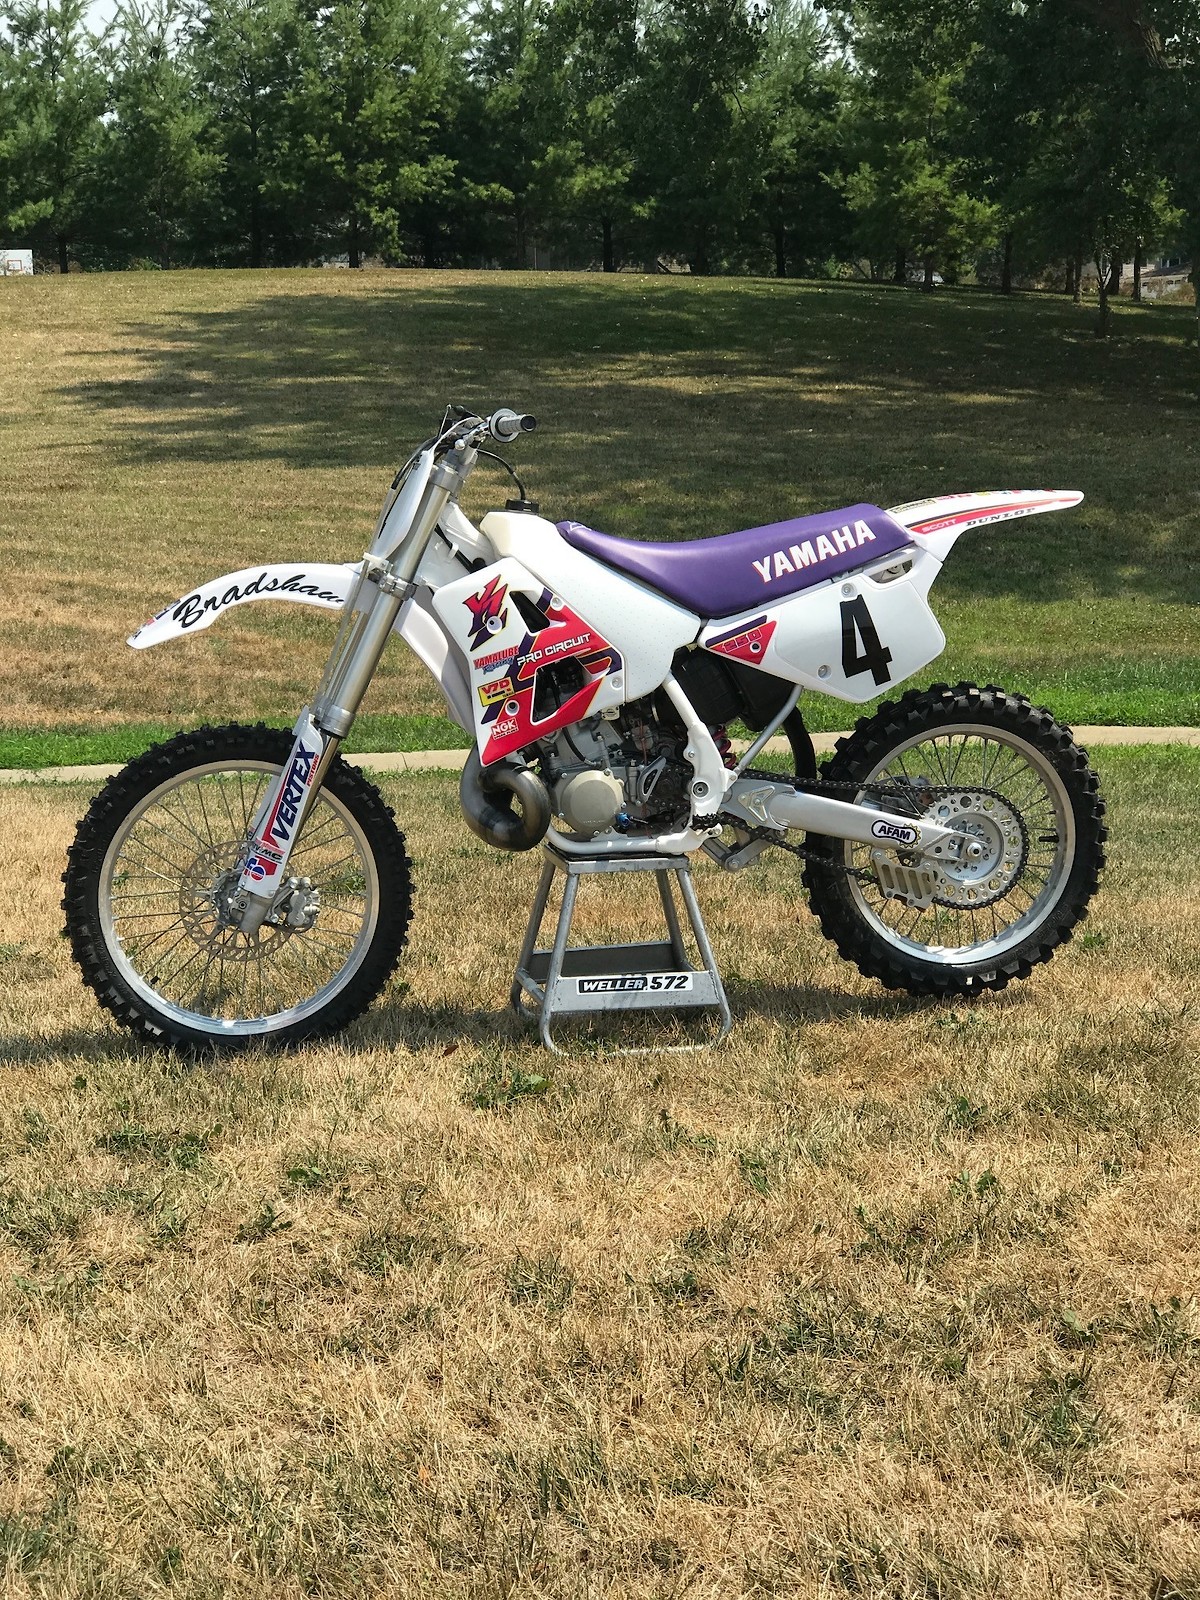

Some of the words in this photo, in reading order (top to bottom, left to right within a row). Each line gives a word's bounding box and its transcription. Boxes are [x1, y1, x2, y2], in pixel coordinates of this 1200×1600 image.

[966, 507, 1036, 527] DUNLOP
[752, 519, 878, 583] YAMAHA
[517, 650, 543, 666] PRO
[544, 633, 591, 656] CIRCUIT
[839, 594, 893, 687] 4
[473, 645, 520, 670] YAMALUBE
[492, 719, 516, 736] NGK
[306, 753, 320, 787] PISTONS
[271, 740, 316, 841] VERTEX
[877, 824, 912, 841] AFAM
[583, 979, 644, 992] WELLER
[649, 975, 689, 990] 572
